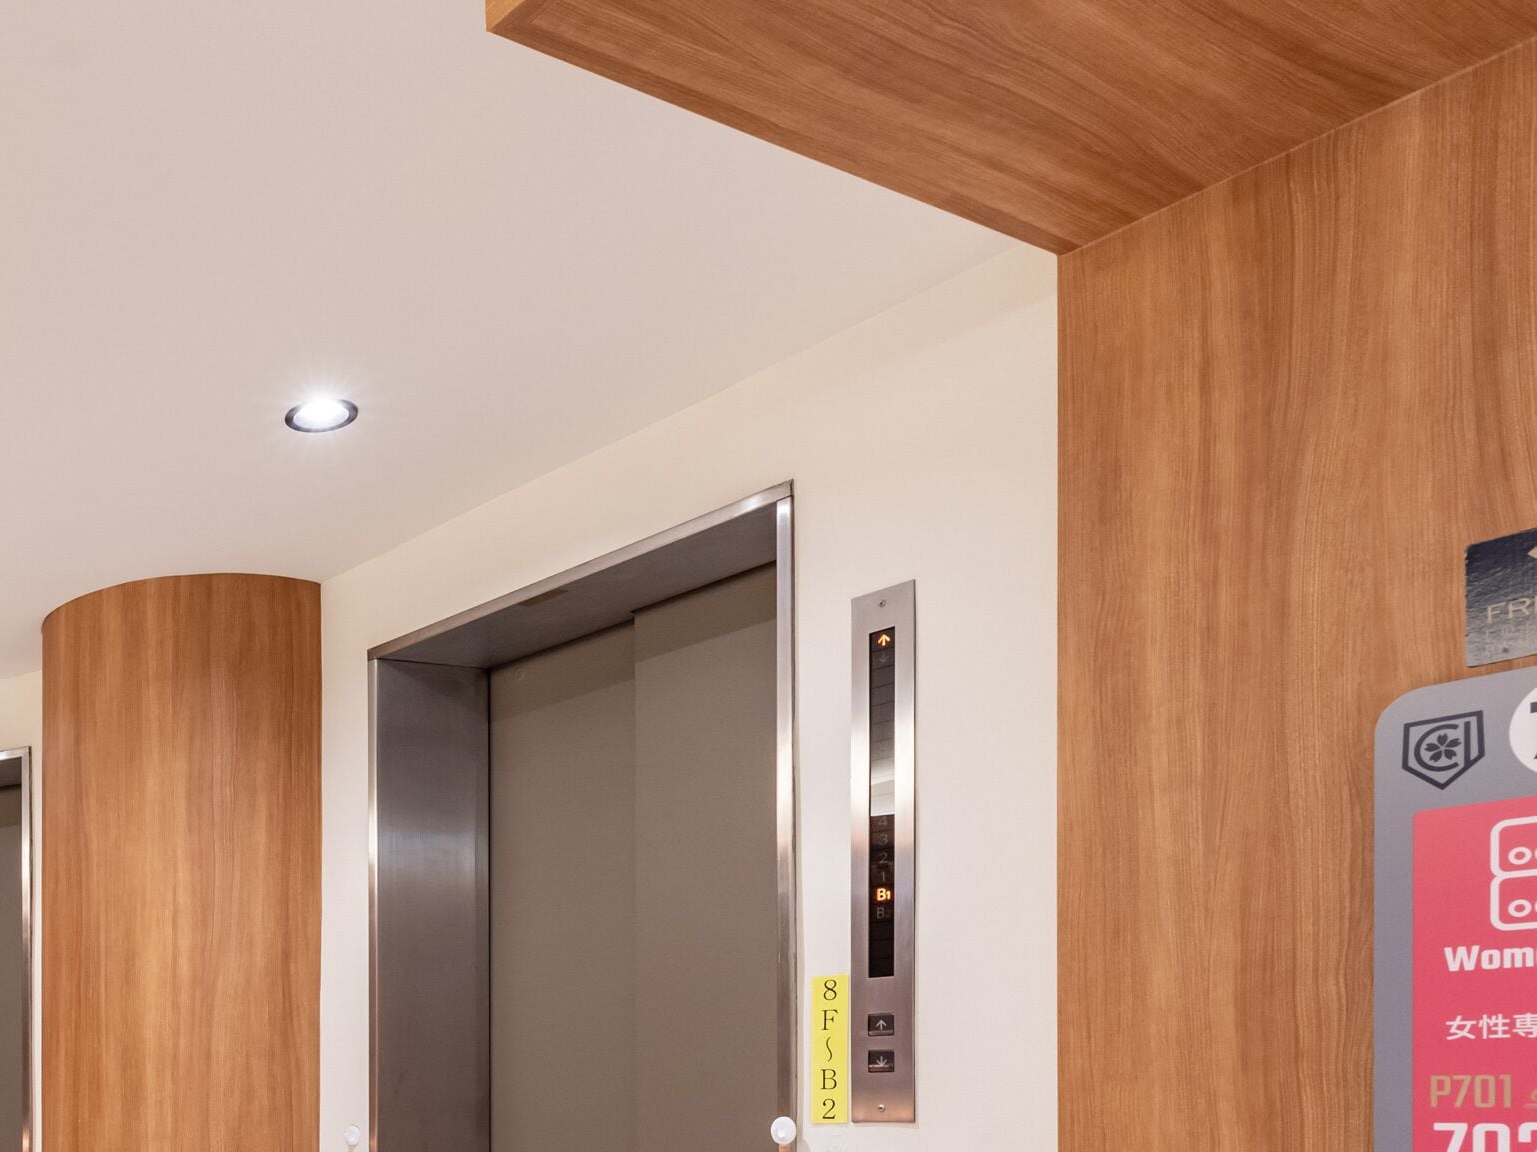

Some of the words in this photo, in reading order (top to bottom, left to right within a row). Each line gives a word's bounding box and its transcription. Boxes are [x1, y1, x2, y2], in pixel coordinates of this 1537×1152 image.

[1486, 596, 1537, 624] FR
[878, 816, 889, 828] 4
[878, 833, 889, 846] 3
[878, 852, 889, 864] 2
[876, 887, 891, 901] B1
[1444, 945, 1537, 972] Wom
[1430, 1074, 1512, 1108] P701
